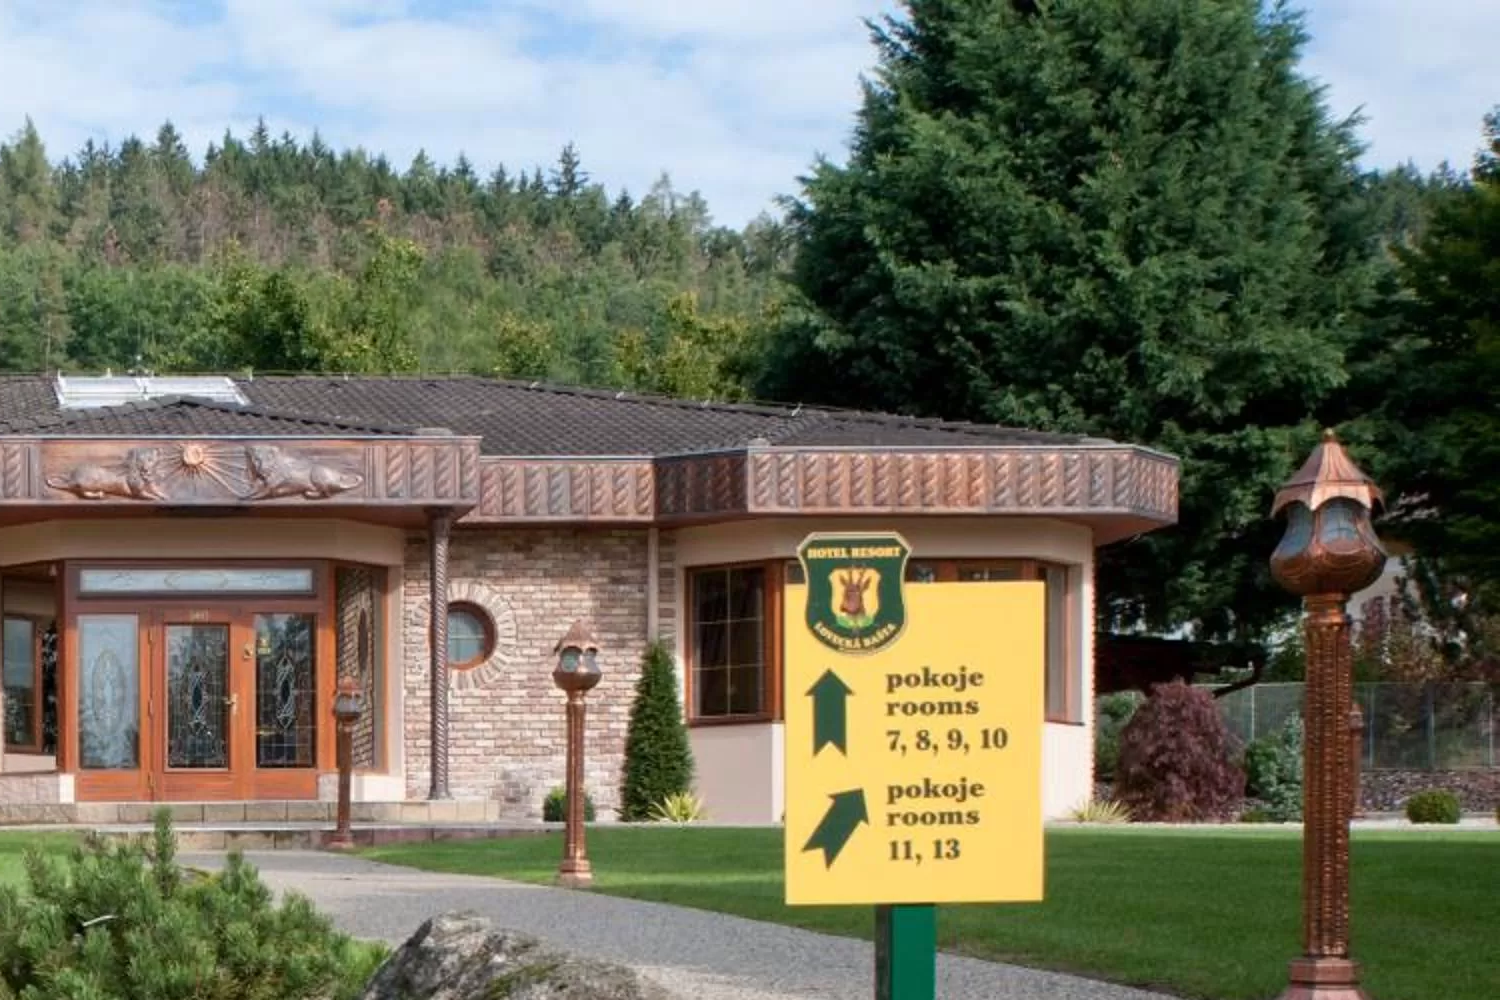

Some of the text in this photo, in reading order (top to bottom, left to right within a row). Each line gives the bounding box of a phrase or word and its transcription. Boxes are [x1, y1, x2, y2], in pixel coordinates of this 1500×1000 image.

[807, 546, 901, 559] HOTEL RESORT
[886, 666, 984, 693] pokoje
[886, 701, 979, 716] rooms
[886, 728, 1008, 756] 7, 8, 9, 10
[886, 777, 985, 804] pokoje
[887, 811, 980, 826] rooms
[888, 839, 961, 865] 11, 13
